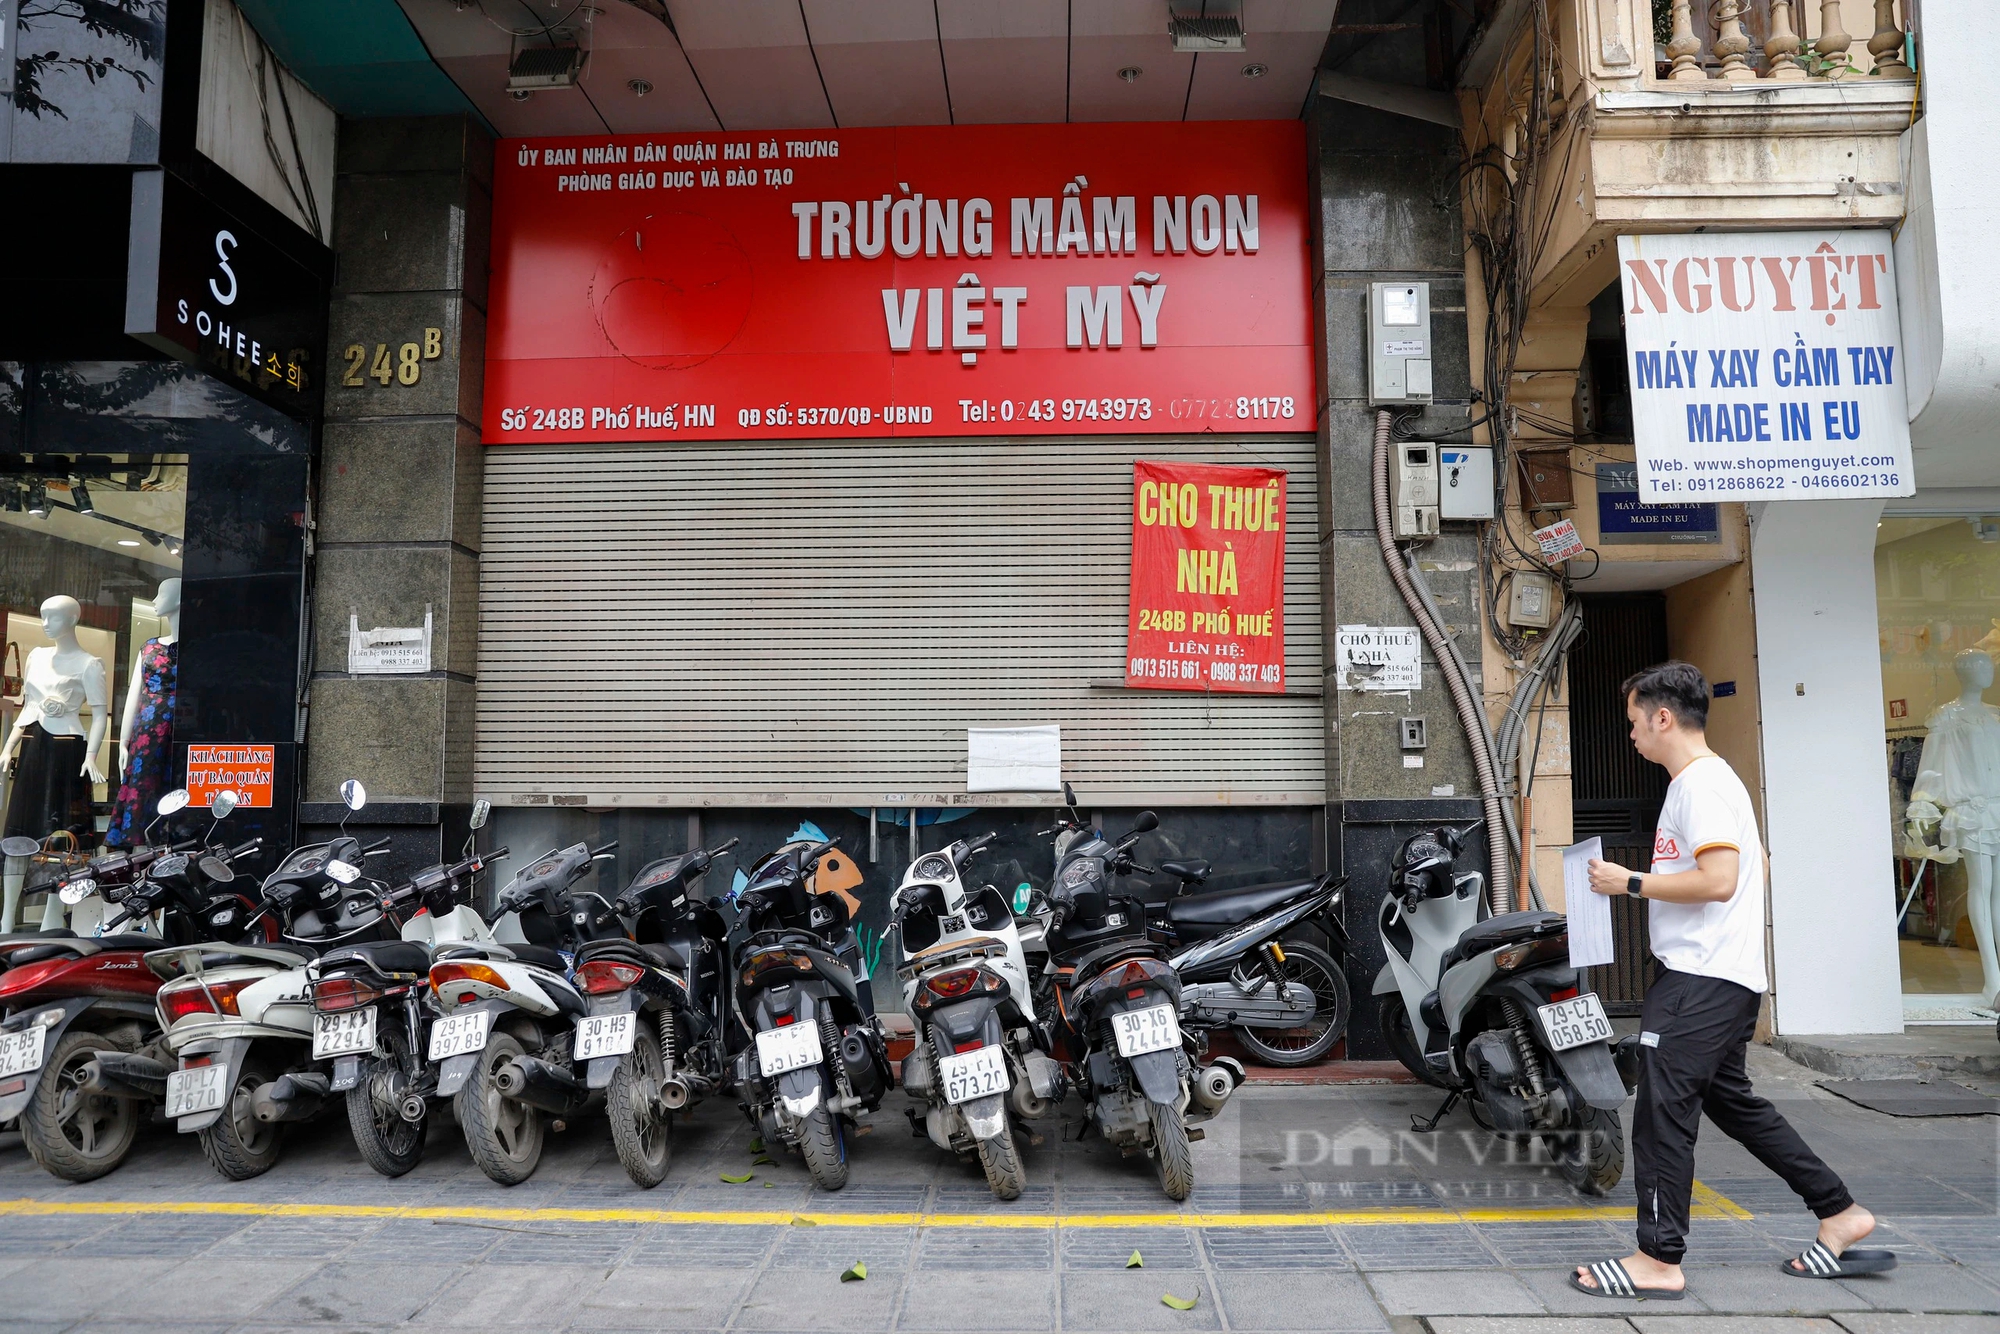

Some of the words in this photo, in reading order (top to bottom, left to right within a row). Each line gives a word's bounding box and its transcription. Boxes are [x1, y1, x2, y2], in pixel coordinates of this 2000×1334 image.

[518, 144, 539, 167] ỦY
[544, 148, 576, 166] BAN
[582, 143, 627, 165] NHÂN
[634, 141, 667, 163] DÂN
[672, 141, 717, 164] QUẬN
[724, 142, 751, 160] HAI
[758, 138, 780, 159] BÀ
[785, 139, 840, 158] TRƯNG
[558, 171, 612, 192] PHÒNG
[618, 169, 656, 190] GIÁO
[700, 167, 721, 188] VÀ
[726, 166, 758, 187] ĐÀO
[764, 168, 794, 187] TẠO
[792, 183, 993, 260] TRƯỜNG
[1010, 175, 1137, 256] MẦM
[1153, 194, 1260, 255] NON
[1625, 241, 1886, 326] NGUYỆT
[882, 272, 1027, 366] VIỆT
[1066, 271, 1168, 349] MỸ
[177, 299, 261, 366] SOHEE
[1635, 340, 1698, 389] MÁY
[1708, 349, 1760, 388] XAY
[1773, 331, 1839, 388] CẦM
[1847, 346, 1894, 386] TAY
[501, 404, 531, 431] Số
[532, 408, 585, 430] 248B
[591, 403, 637, 430] Phố
[684, 405, 715, 428] HN
[738, 408, 760, 428] QĐ
[765, 401, 793, 426] SỐ:
[958, 399, 995, 422] Tel:
[1062, 398, 1152, 422] 9743973
[1686, 402, 1771, 442] MADE
[1780, 402, 1812, 441] IN
[1823, 401, 1861, 441] EU
[1649, 458, 1688, 472] Web.
[1694, 454, 1895, 472] www.shopmenguyet.com
[1650, 478, 1682, 493] Tel:
[1687, 475, 1785, 493] 0912868622
[1138, 481, 1198, 529] CHO
[1208, 478, 1281, 532] THUÊ
[1176, 541, 1238, 596] NHÀ
[1138, 608, 1187, 632] 248B
[1192, 605, 1231, 635] PHỐ
[1236, 608, 1275, 637] HUẾ
[1168, 640, 1210, 656] LIÊN
[1214, 641, 1245, 658] HỆ:
[1374, 632, 1413, 646] THUÊ
[1130, 658, 1156, 677] 0913
[1158, 660, 1179, 678] 515
[1181, 660, 1200, 679] 661
[1210, 661, 1237, 681] 0988
[1239, 663, 1260, 682] 337
[1262, 664, 1280, 683] 403
[1401, 664, 1414, 672] 661
[190, 747, 234, 764] KHÁCH
[236, 747, 271, 764] HÀNG
[189, 769, 208, 787] TỰ
[208, 768, 234, 784] BẢO
[236, 768, 270, 787] QUẢN
[440, 1014, 479, 1037] 29-F1
[1122, 1009, 1167, 1033] 30-X6
[1548, 999, 1594, 1026] 29-C2
[322, 1029, 364, 1051] 2294
[434, 1031, 482, 1056] 397.89
[1126, 1027, 1172, 1053] 2444
[1551, 1018, 1607, 1047] 058.50
[176, 1068, 218, 1092] 30-L7
[949, 1070, 1004, 1100] 673.20
[174, 1088, 216, 1113] 7670
